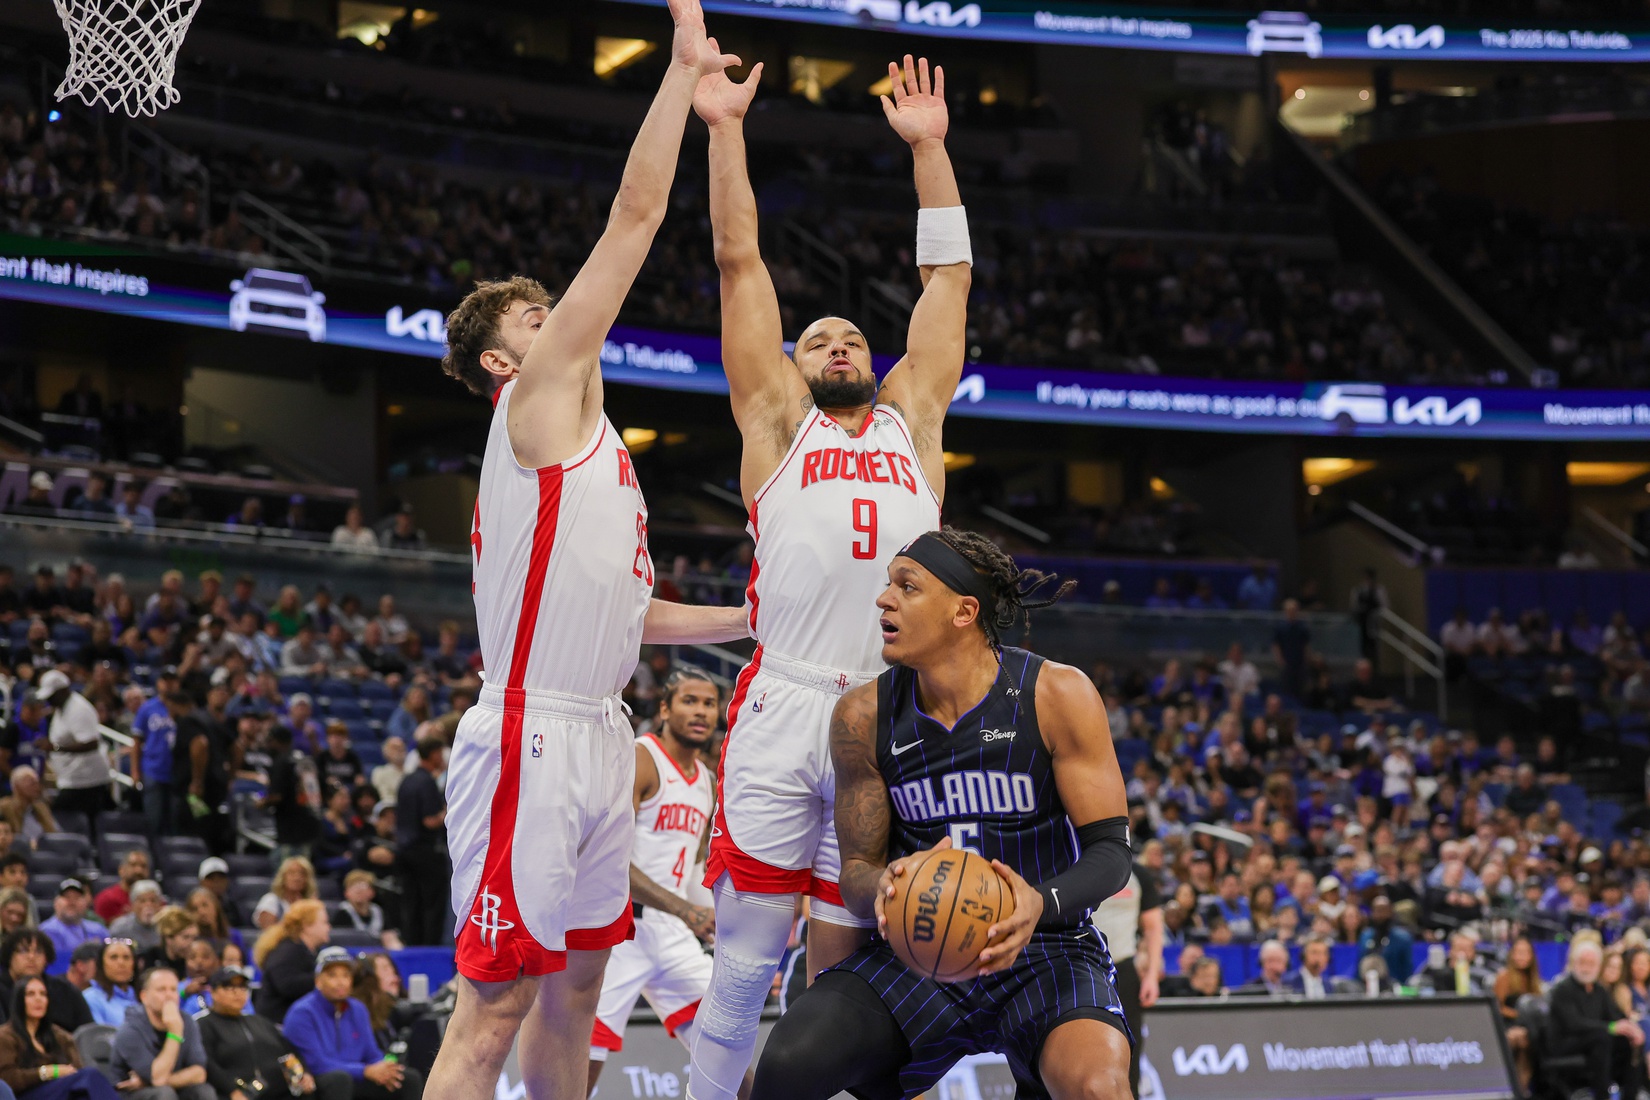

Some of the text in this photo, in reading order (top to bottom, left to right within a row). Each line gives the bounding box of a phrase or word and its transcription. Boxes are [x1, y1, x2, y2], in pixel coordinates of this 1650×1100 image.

[1034, 10, 1192, 39] Movement that inspires
[1479, 29, 1508, 48] The
[31, 257, 72, 286] that
[74, 262, 148, 296] inspires
[1052, 384, 1088, 409] only
[1089, 388, 1126, 409] your
[1171, 393, 1211, 413] were
[1211, 395, 1231, 414] as
[1231, 394, 1276, 419] good
[1276, 397, 1297, 417] as
[1544, 403, 1633, 425] Movement
[801, 447, 917, 495] ROCKETS
[852, 498, 877, 560] 9
[889, 769, 1037, 822] ORLANDO
[671, 846, 687, 888] 4
[913, 860, 956, 943] Wilson
[1263, 1037, 1484, 1071] Movement that inspires
[622, 1065, 681, 1099] The
